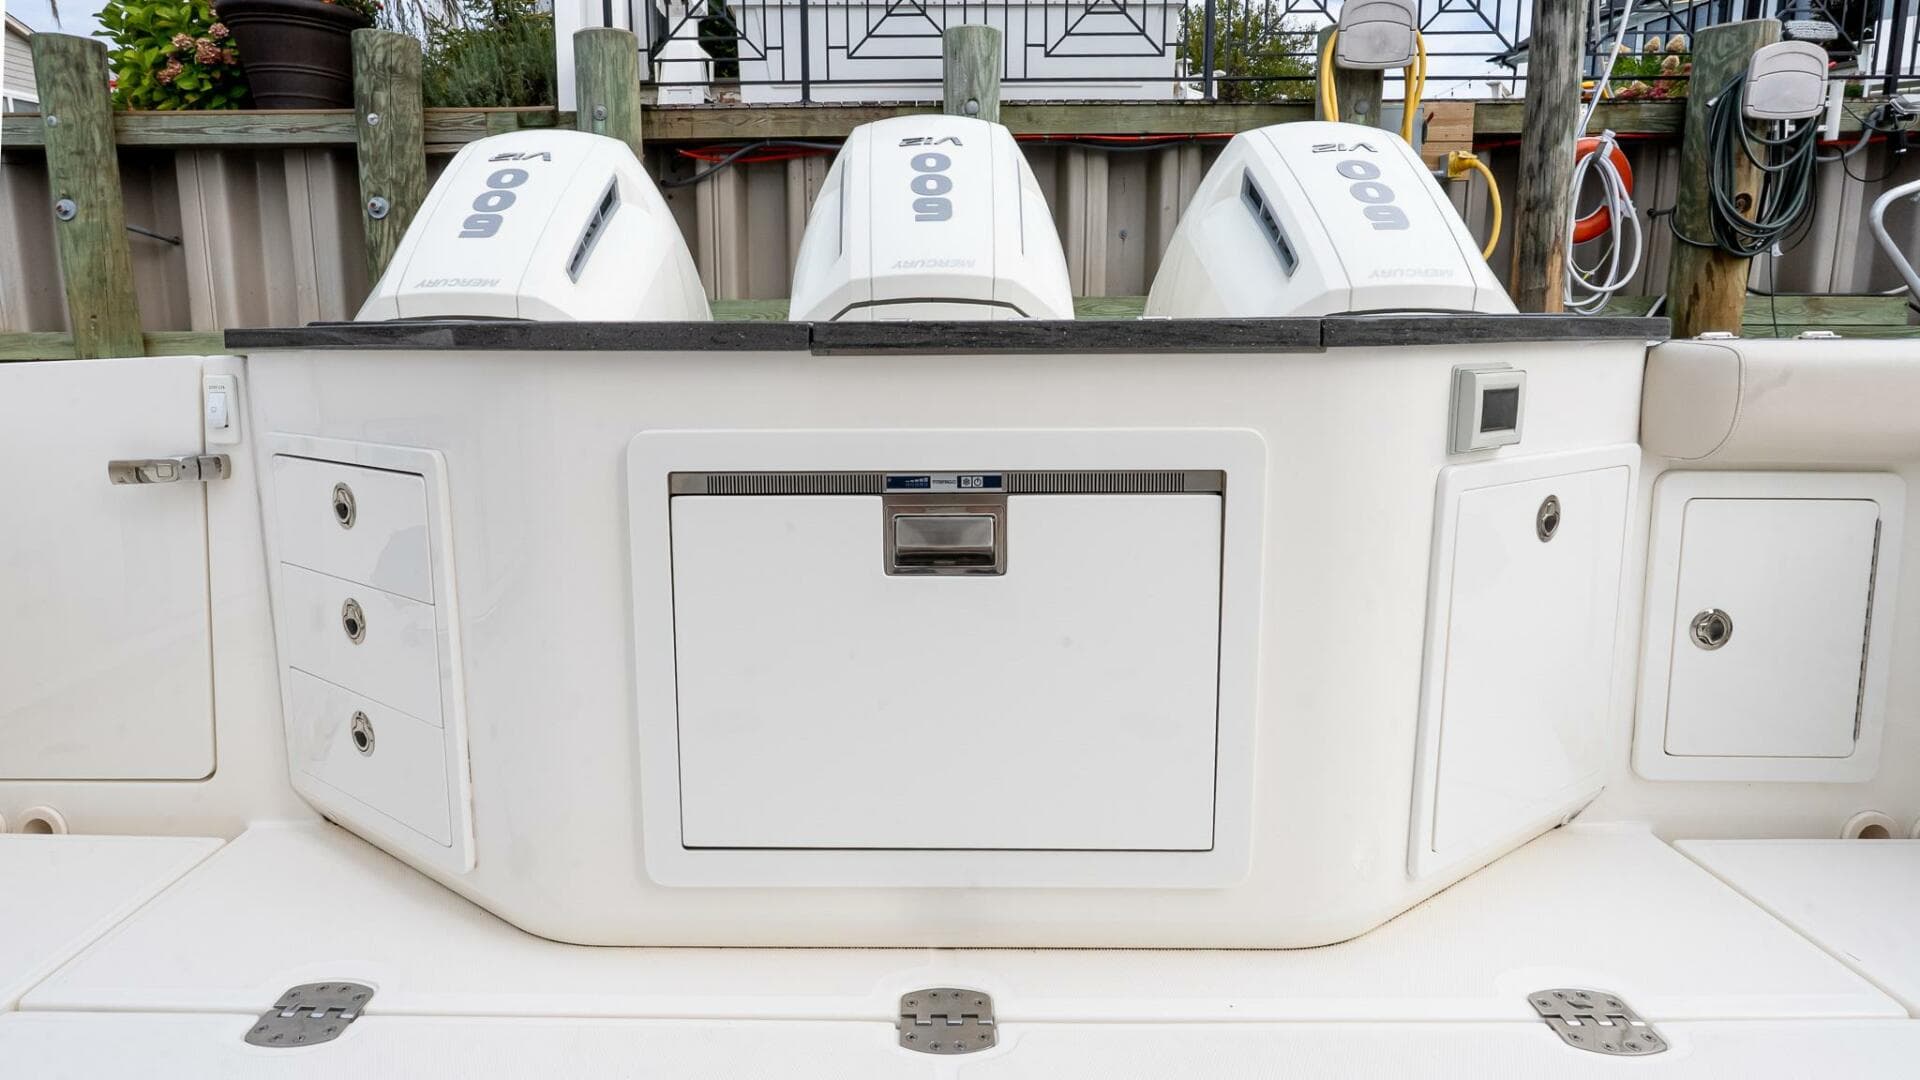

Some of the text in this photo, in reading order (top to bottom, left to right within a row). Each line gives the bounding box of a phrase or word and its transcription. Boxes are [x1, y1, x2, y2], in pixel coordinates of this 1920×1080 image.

[898, 136, 964, 147] V12
[1312, 142, 1379, 153] V12
[488, 151, 552, 163] V12
[910, 152, 953, 222] 600
[1336, 159, 1410, 231] 600
[458, 168, 529, 239] 600
[891, 258, 976, 270] MERCURY
[1369, 268, 1455, 280] MERCURY
[413, 278, 502, 289] MERCURY
